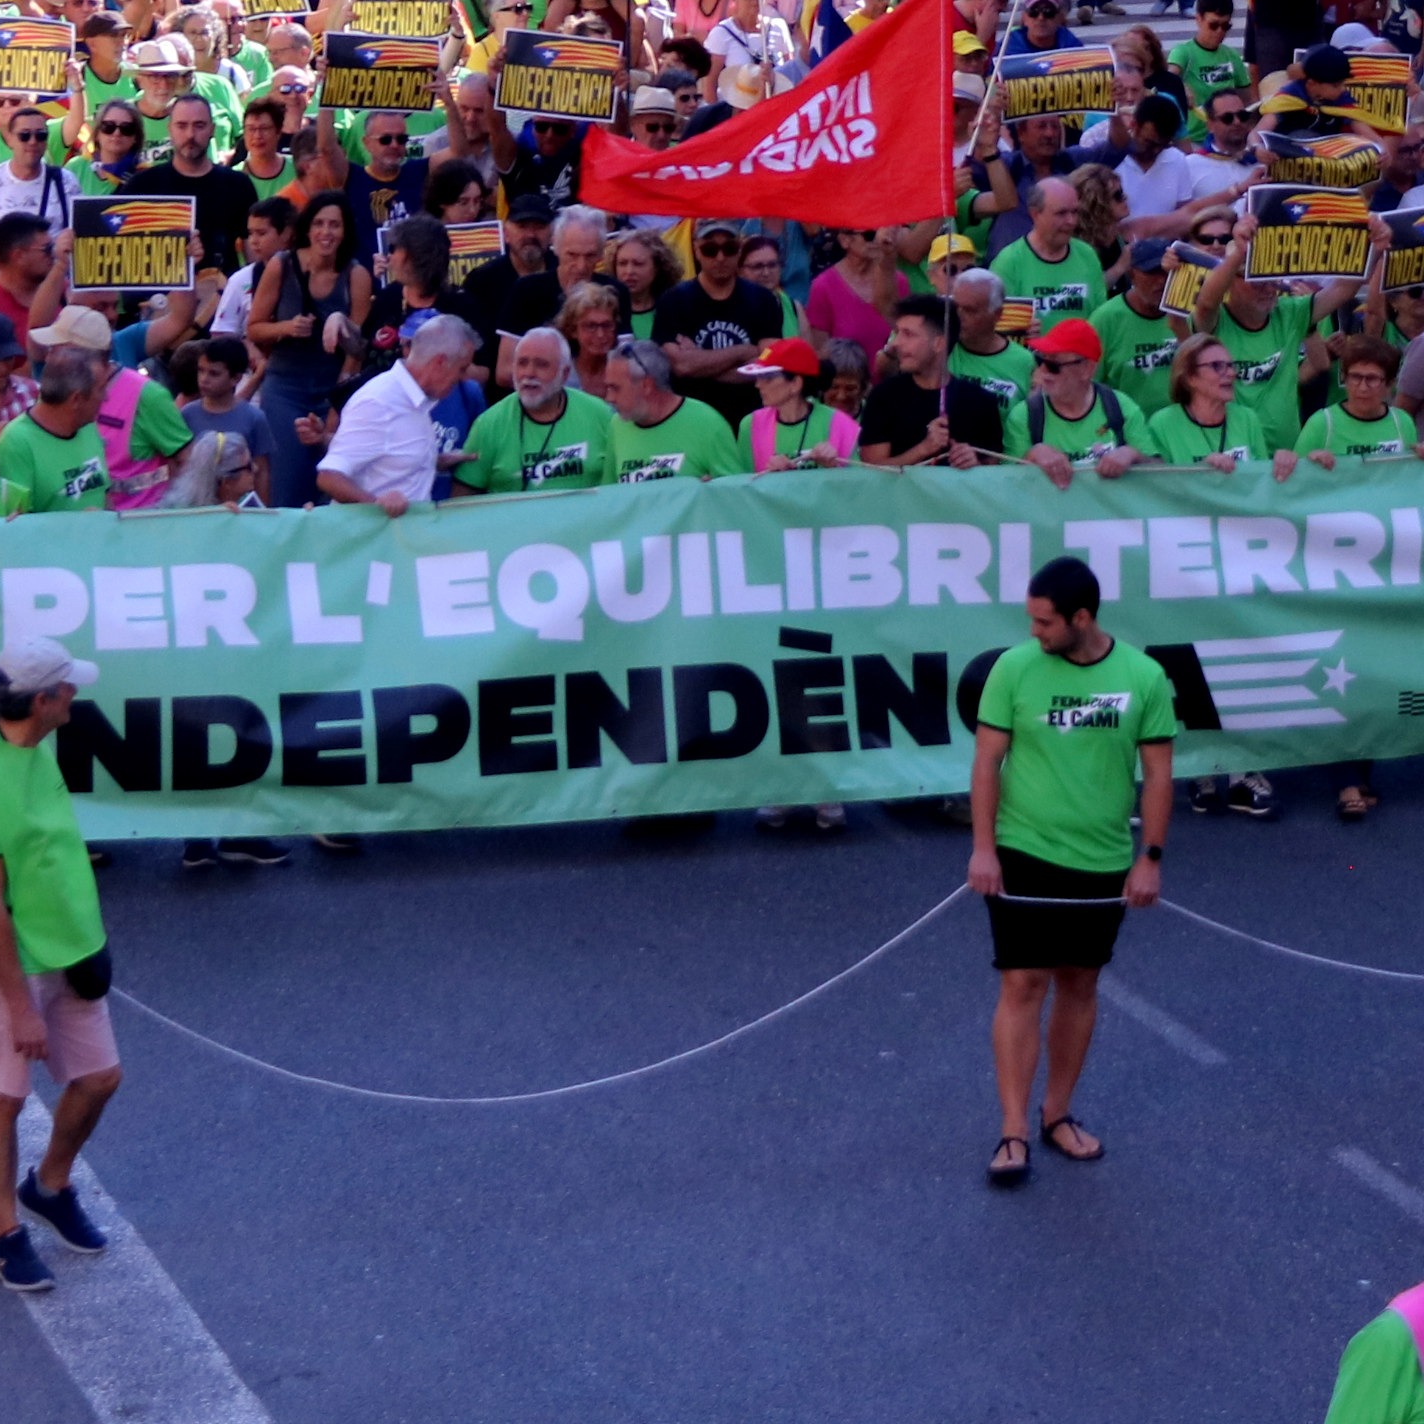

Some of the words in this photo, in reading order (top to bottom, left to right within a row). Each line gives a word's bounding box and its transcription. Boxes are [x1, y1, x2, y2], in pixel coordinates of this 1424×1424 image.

[502, 63, 613, 118] INDEPENDÈNCIA
[73, 231, 189, 287] INDEPENDÈNCIA
[1251, 221, 1368, 277] INDEPENDÈNCIA
[1048, 295, 1084, 311] CAMI
[542, 459, 584, 479] CAMI
[0, 561, 260, 651] PER
[287, 516, 1066, 646] L'EQUILIBRI
[1047, 709, 1067, 727] EL
[1070, 708, 1120, 728] CAMI
[1051, 693, 1123, 709] FEM+CURT
